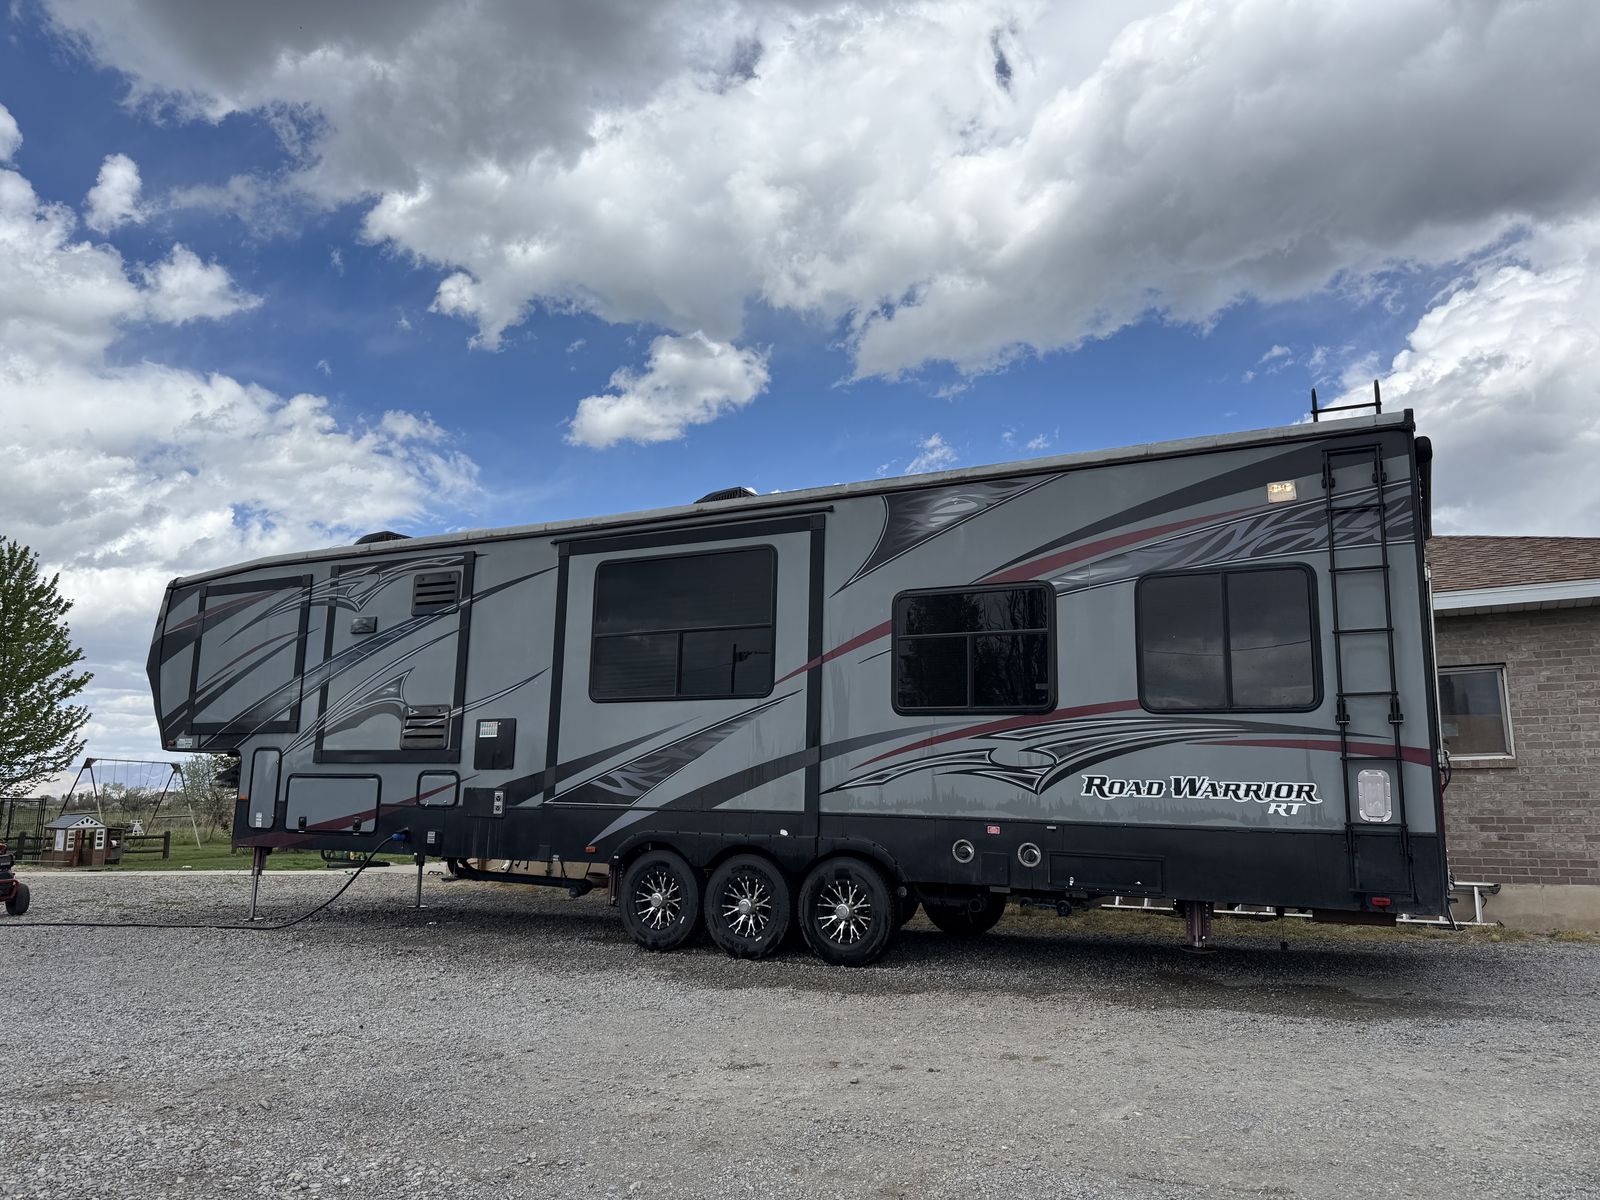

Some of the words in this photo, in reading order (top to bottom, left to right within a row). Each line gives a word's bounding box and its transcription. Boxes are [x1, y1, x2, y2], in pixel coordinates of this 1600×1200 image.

[1081, 774, 1166, 800] ROAD
[1170, 775, 1323, 804] WARRIOR
[1267, 802, 1307, 816] RT
